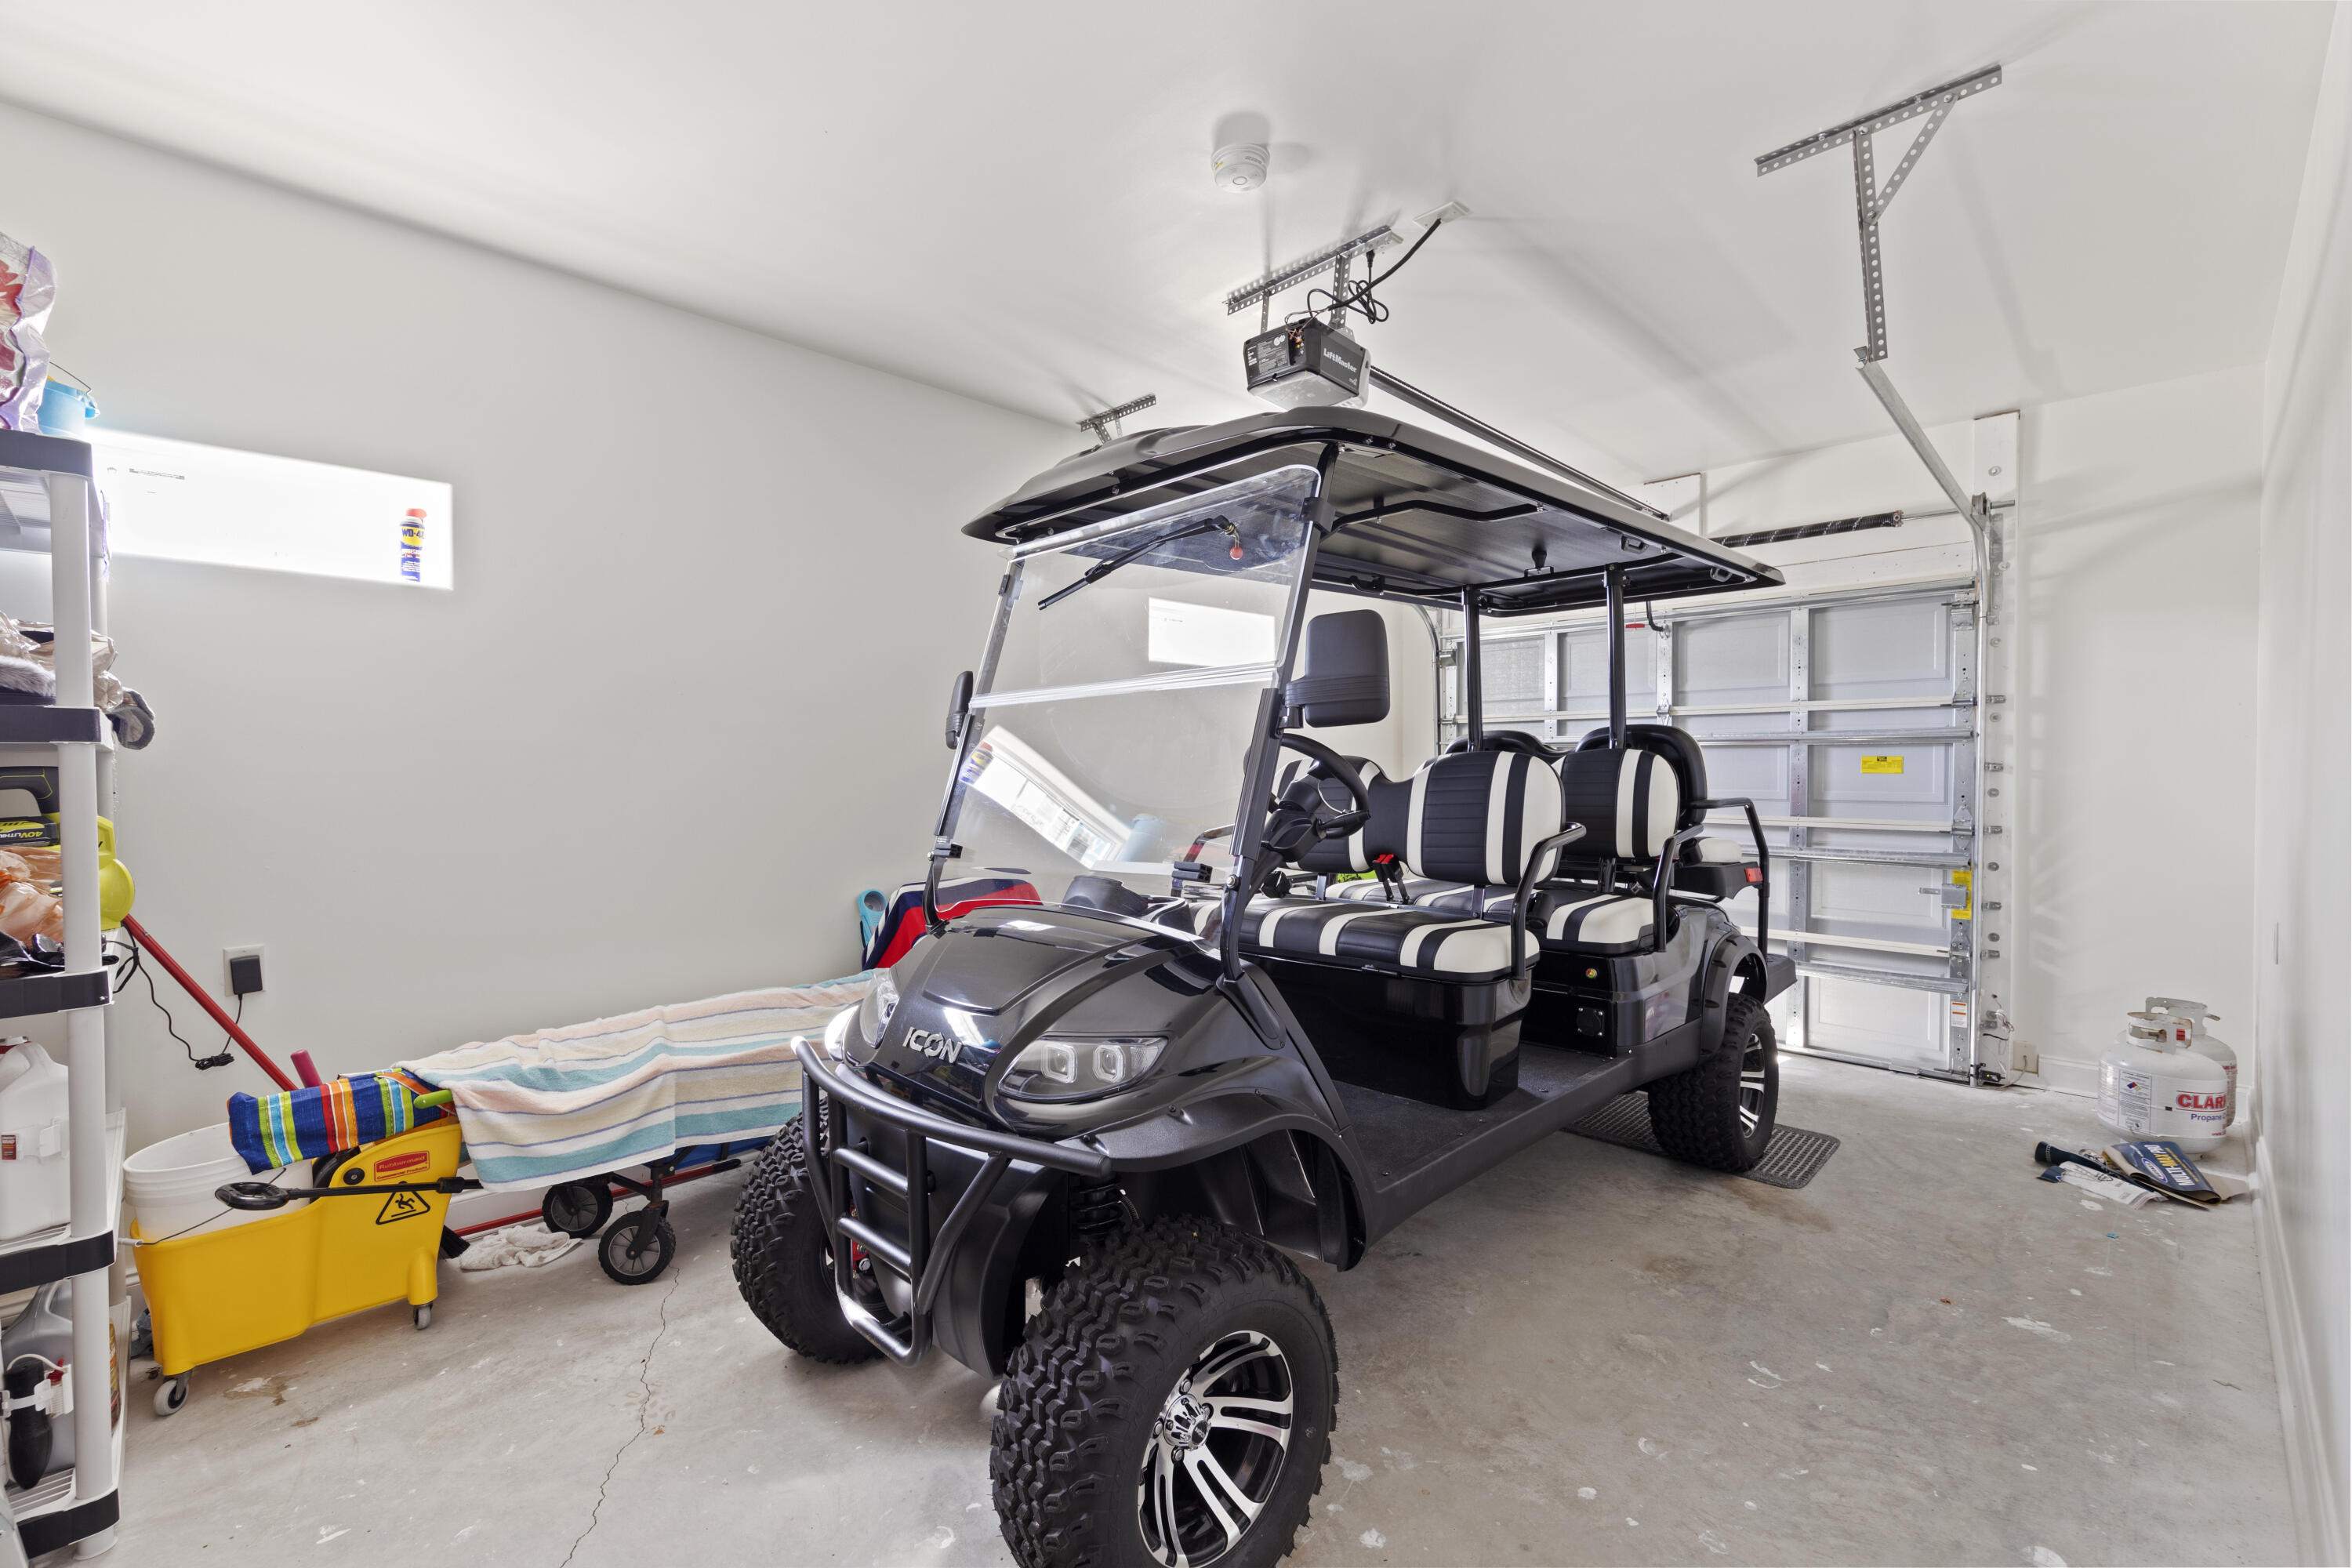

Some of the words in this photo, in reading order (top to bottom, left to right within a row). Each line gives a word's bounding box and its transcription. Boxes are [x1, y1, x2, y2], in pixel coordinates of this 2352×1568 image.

[1323, 347, 1357, 372] LiftMaster
[902, 1026, 962, 1063] ICON
[379, 1156, 426, 1170] Rubbermaid
